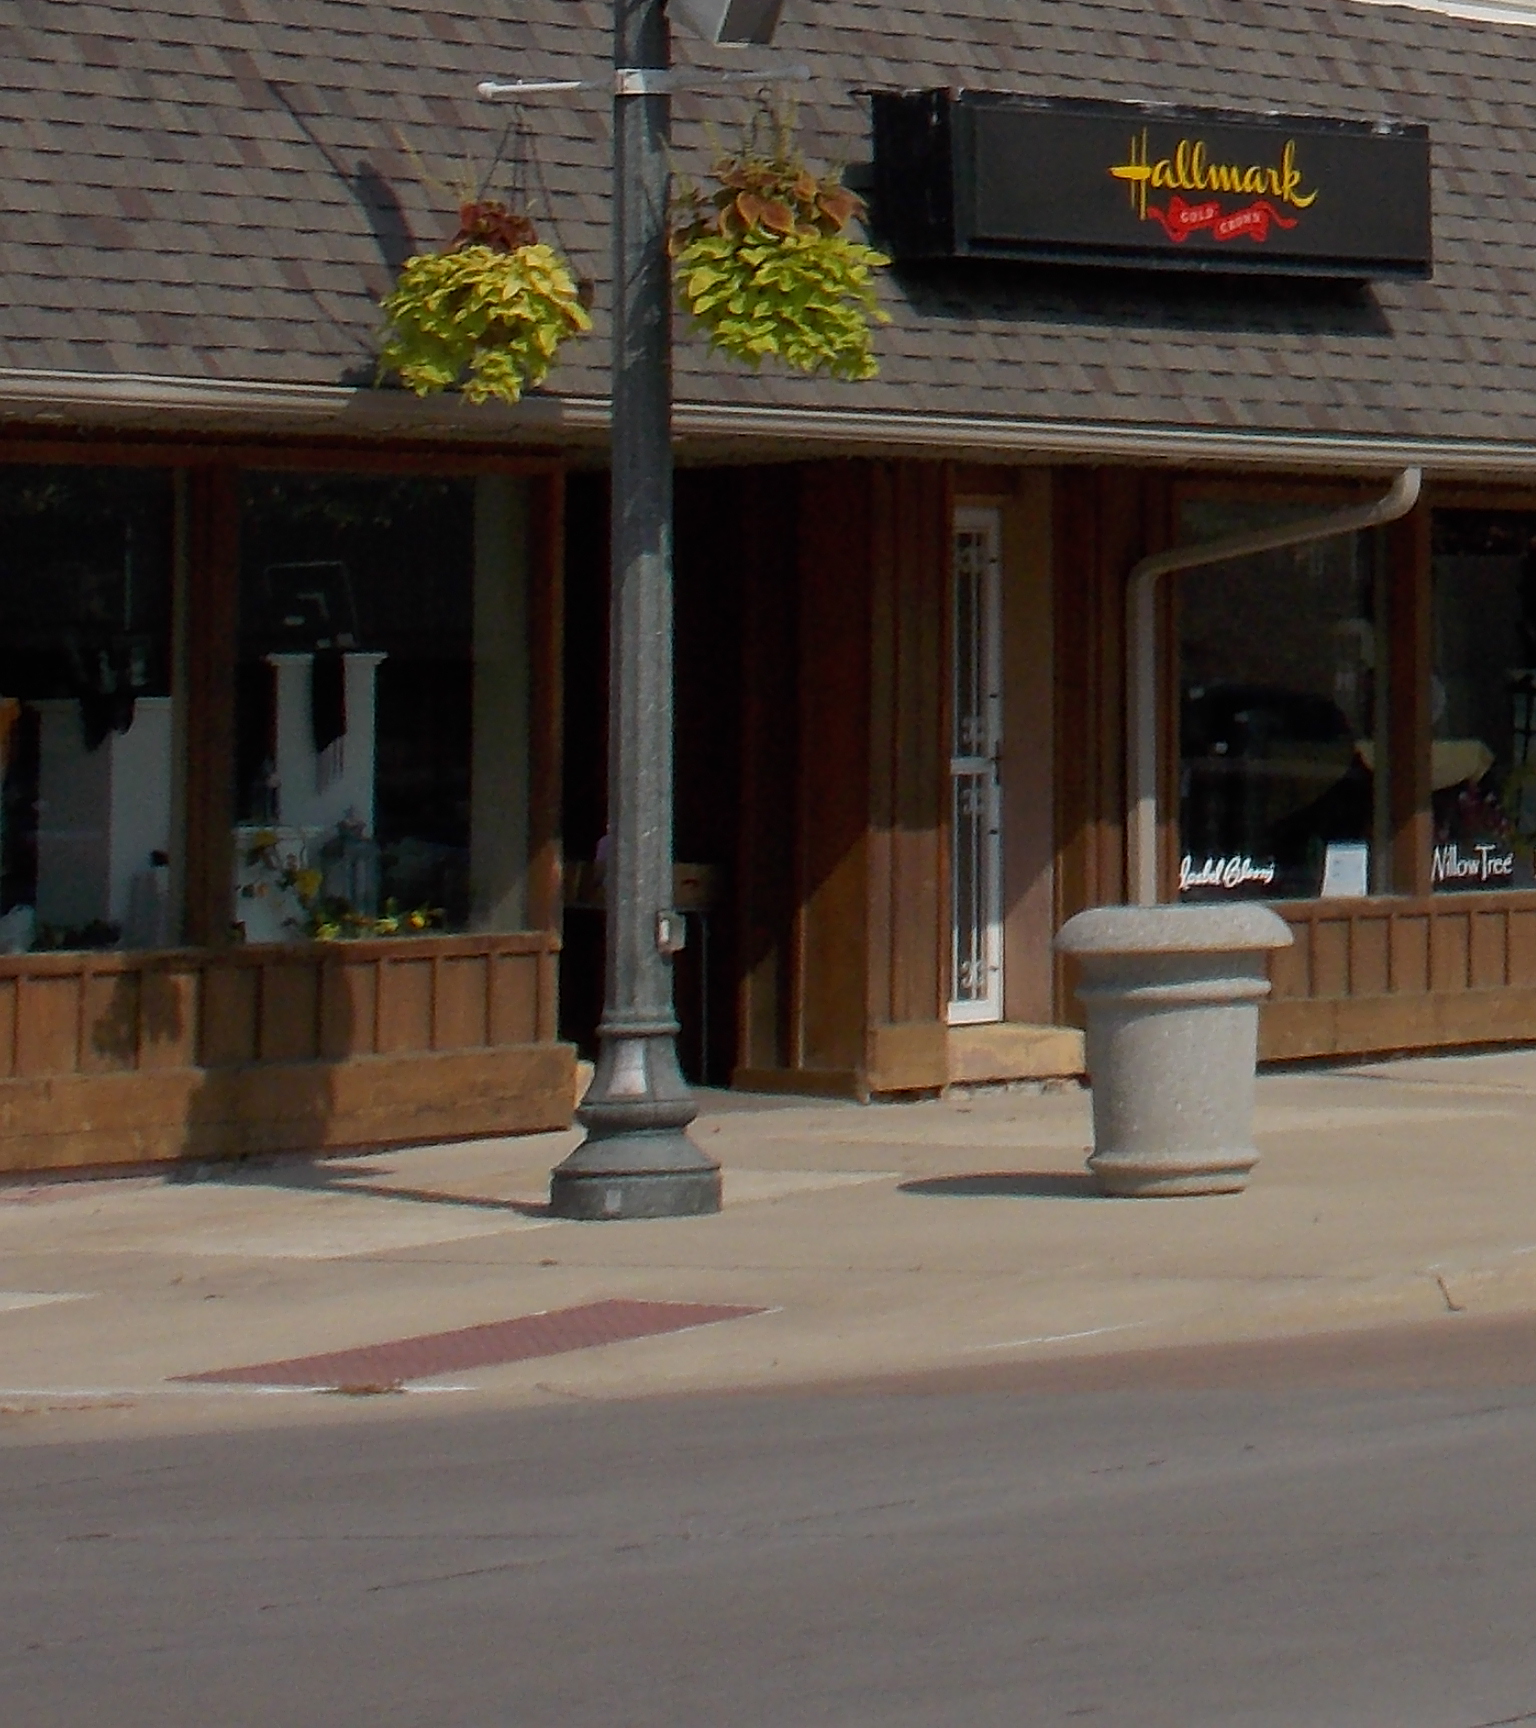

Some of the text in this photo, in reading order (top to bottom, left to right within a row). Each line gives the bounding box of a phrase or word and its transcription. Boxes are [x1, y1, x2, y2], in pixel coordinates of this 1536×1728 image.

[1108, 126, 1318, 221] Hallmark
[1180, 207, 1261, 234] GOLD CROWN
